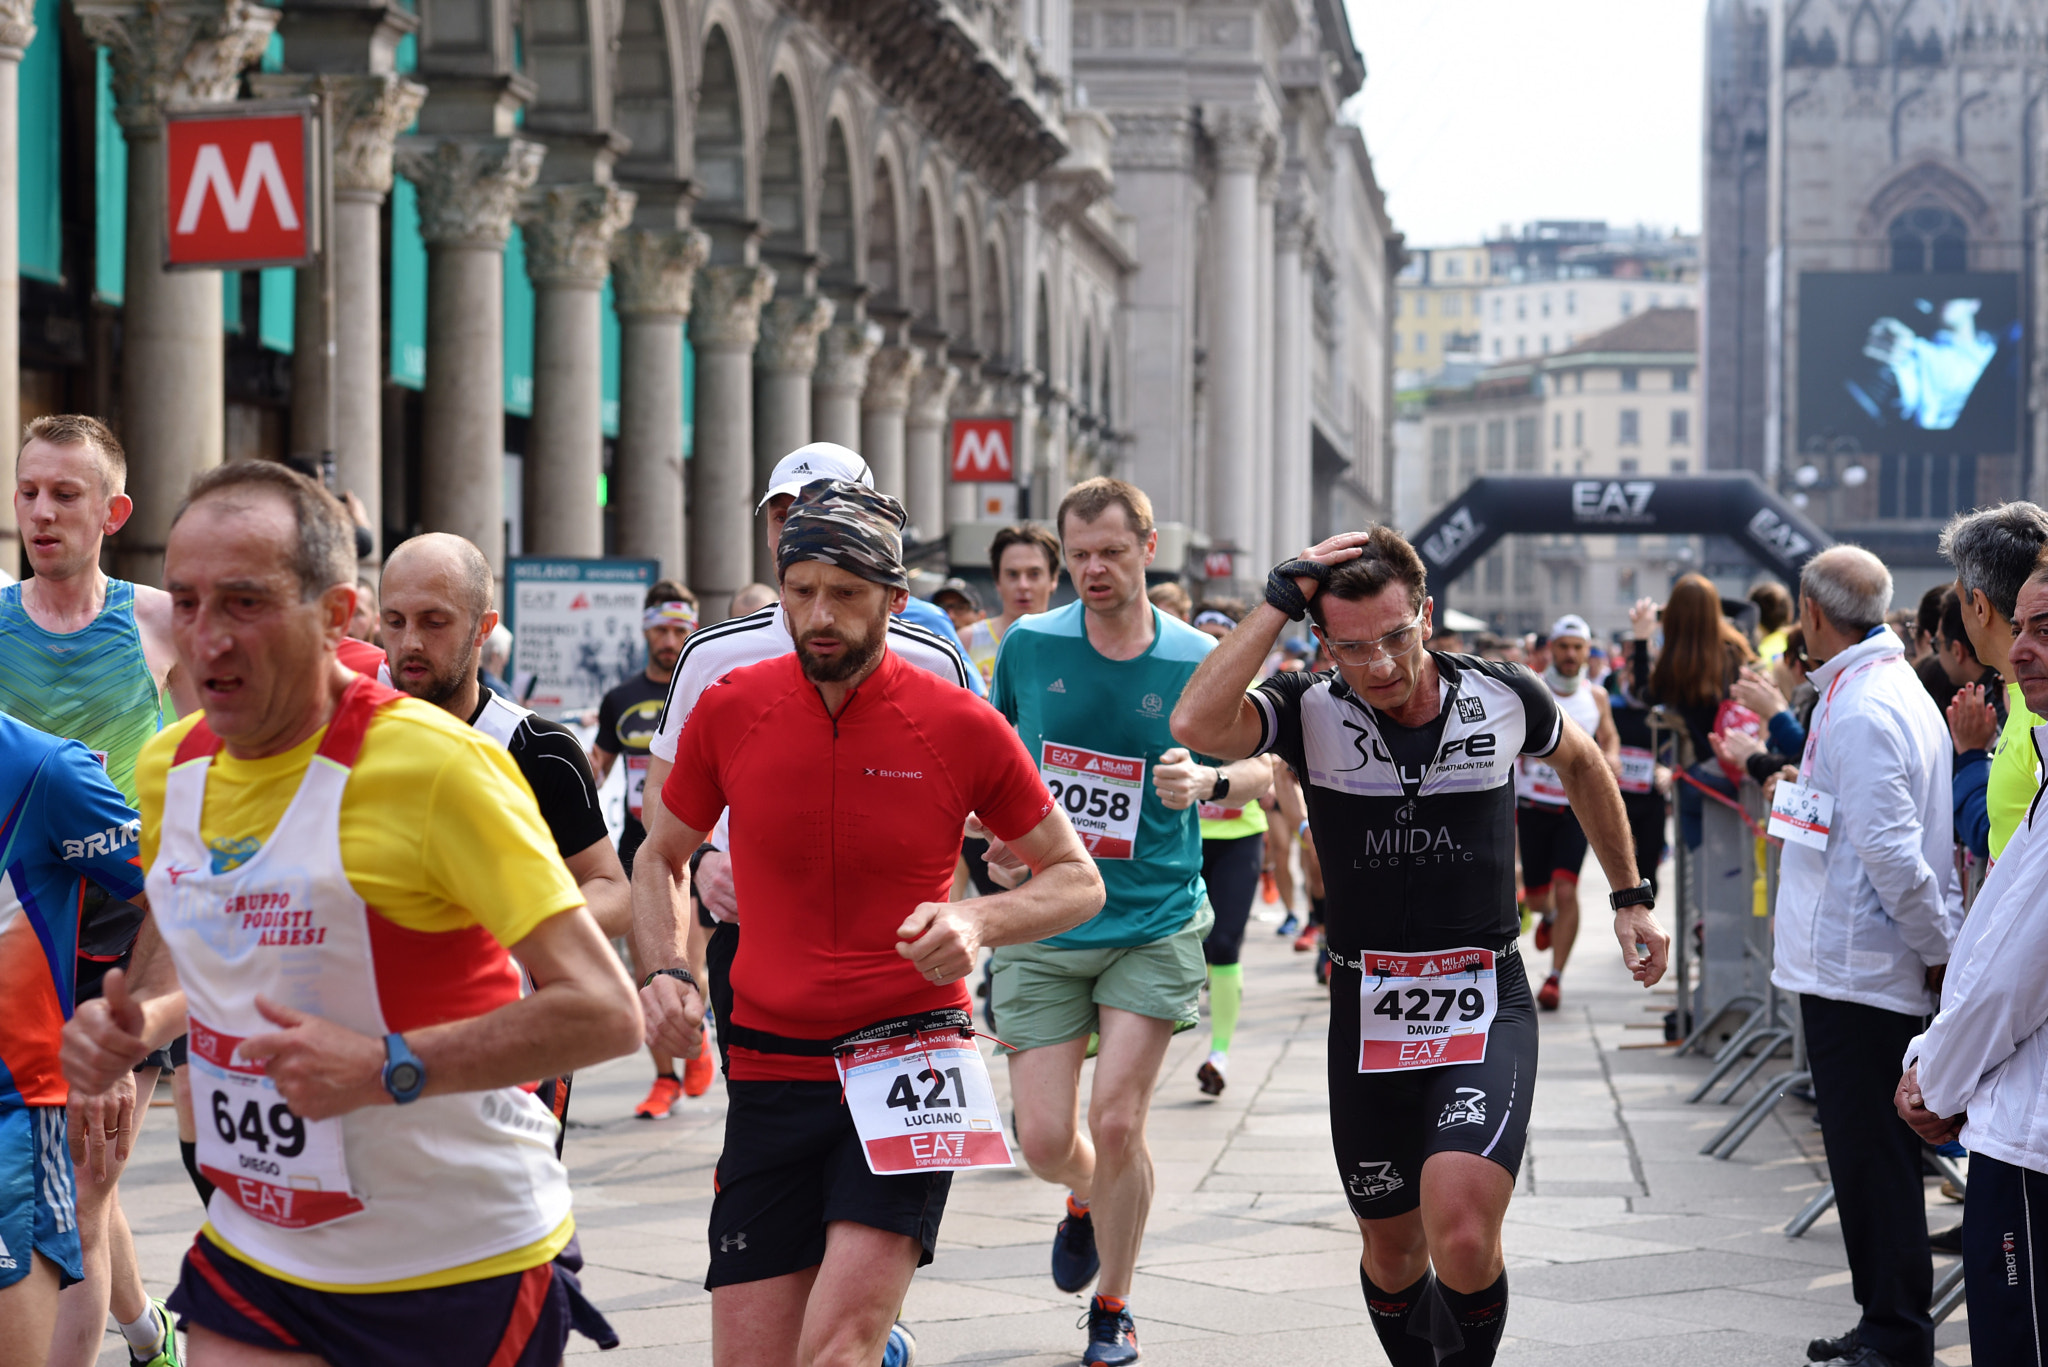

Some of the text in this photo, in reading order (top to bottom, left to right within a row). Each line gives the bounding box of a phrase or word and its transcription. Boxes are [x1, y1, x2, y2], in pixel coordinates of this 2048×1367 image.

[176, 141, 300, 234] M
[954, 429, 1011, 471] M
[1571, 480, 1656, 515] EA7
[1421, 506, 1475, 566] EA7
[1748, 507, 1812, 558] EA7
[1051, 749, 1134, 772] EA7 MILANO
[1475, 760, 1494, 769] TEAM
[1048, 779, 1131, 822] 2058
[1070, 816, 1108, 831] AVOMIR
[62, 818, 142, 861] BRIK
[1353, 851, 1474, 869] LOGSTIC
[225, 892, 290, 914] GRUPPO
[242, 910, 313, 930] PODISTI
[257, 926, 328, 947] ALBESI
[1376, 958, 1409, 973] EA7
[1441, 952, 1480, 967] MILANO
[1373, 987, 1485, 1022] 4279
[1407, 1024, 1451, 1036] DAVIDE
[1399, 1038, 1450, 1061] EA7
[886, 1067, 967, 1112] 421
[212, 1089, 306, 1159] 649
[904, 1112, 962, 1128] LUCIANO
[909, 1133, 966, 1159] EA7
[238, 1153, 280, 1177] DIEGO
[237, 1178, 295, 1220] EA7
